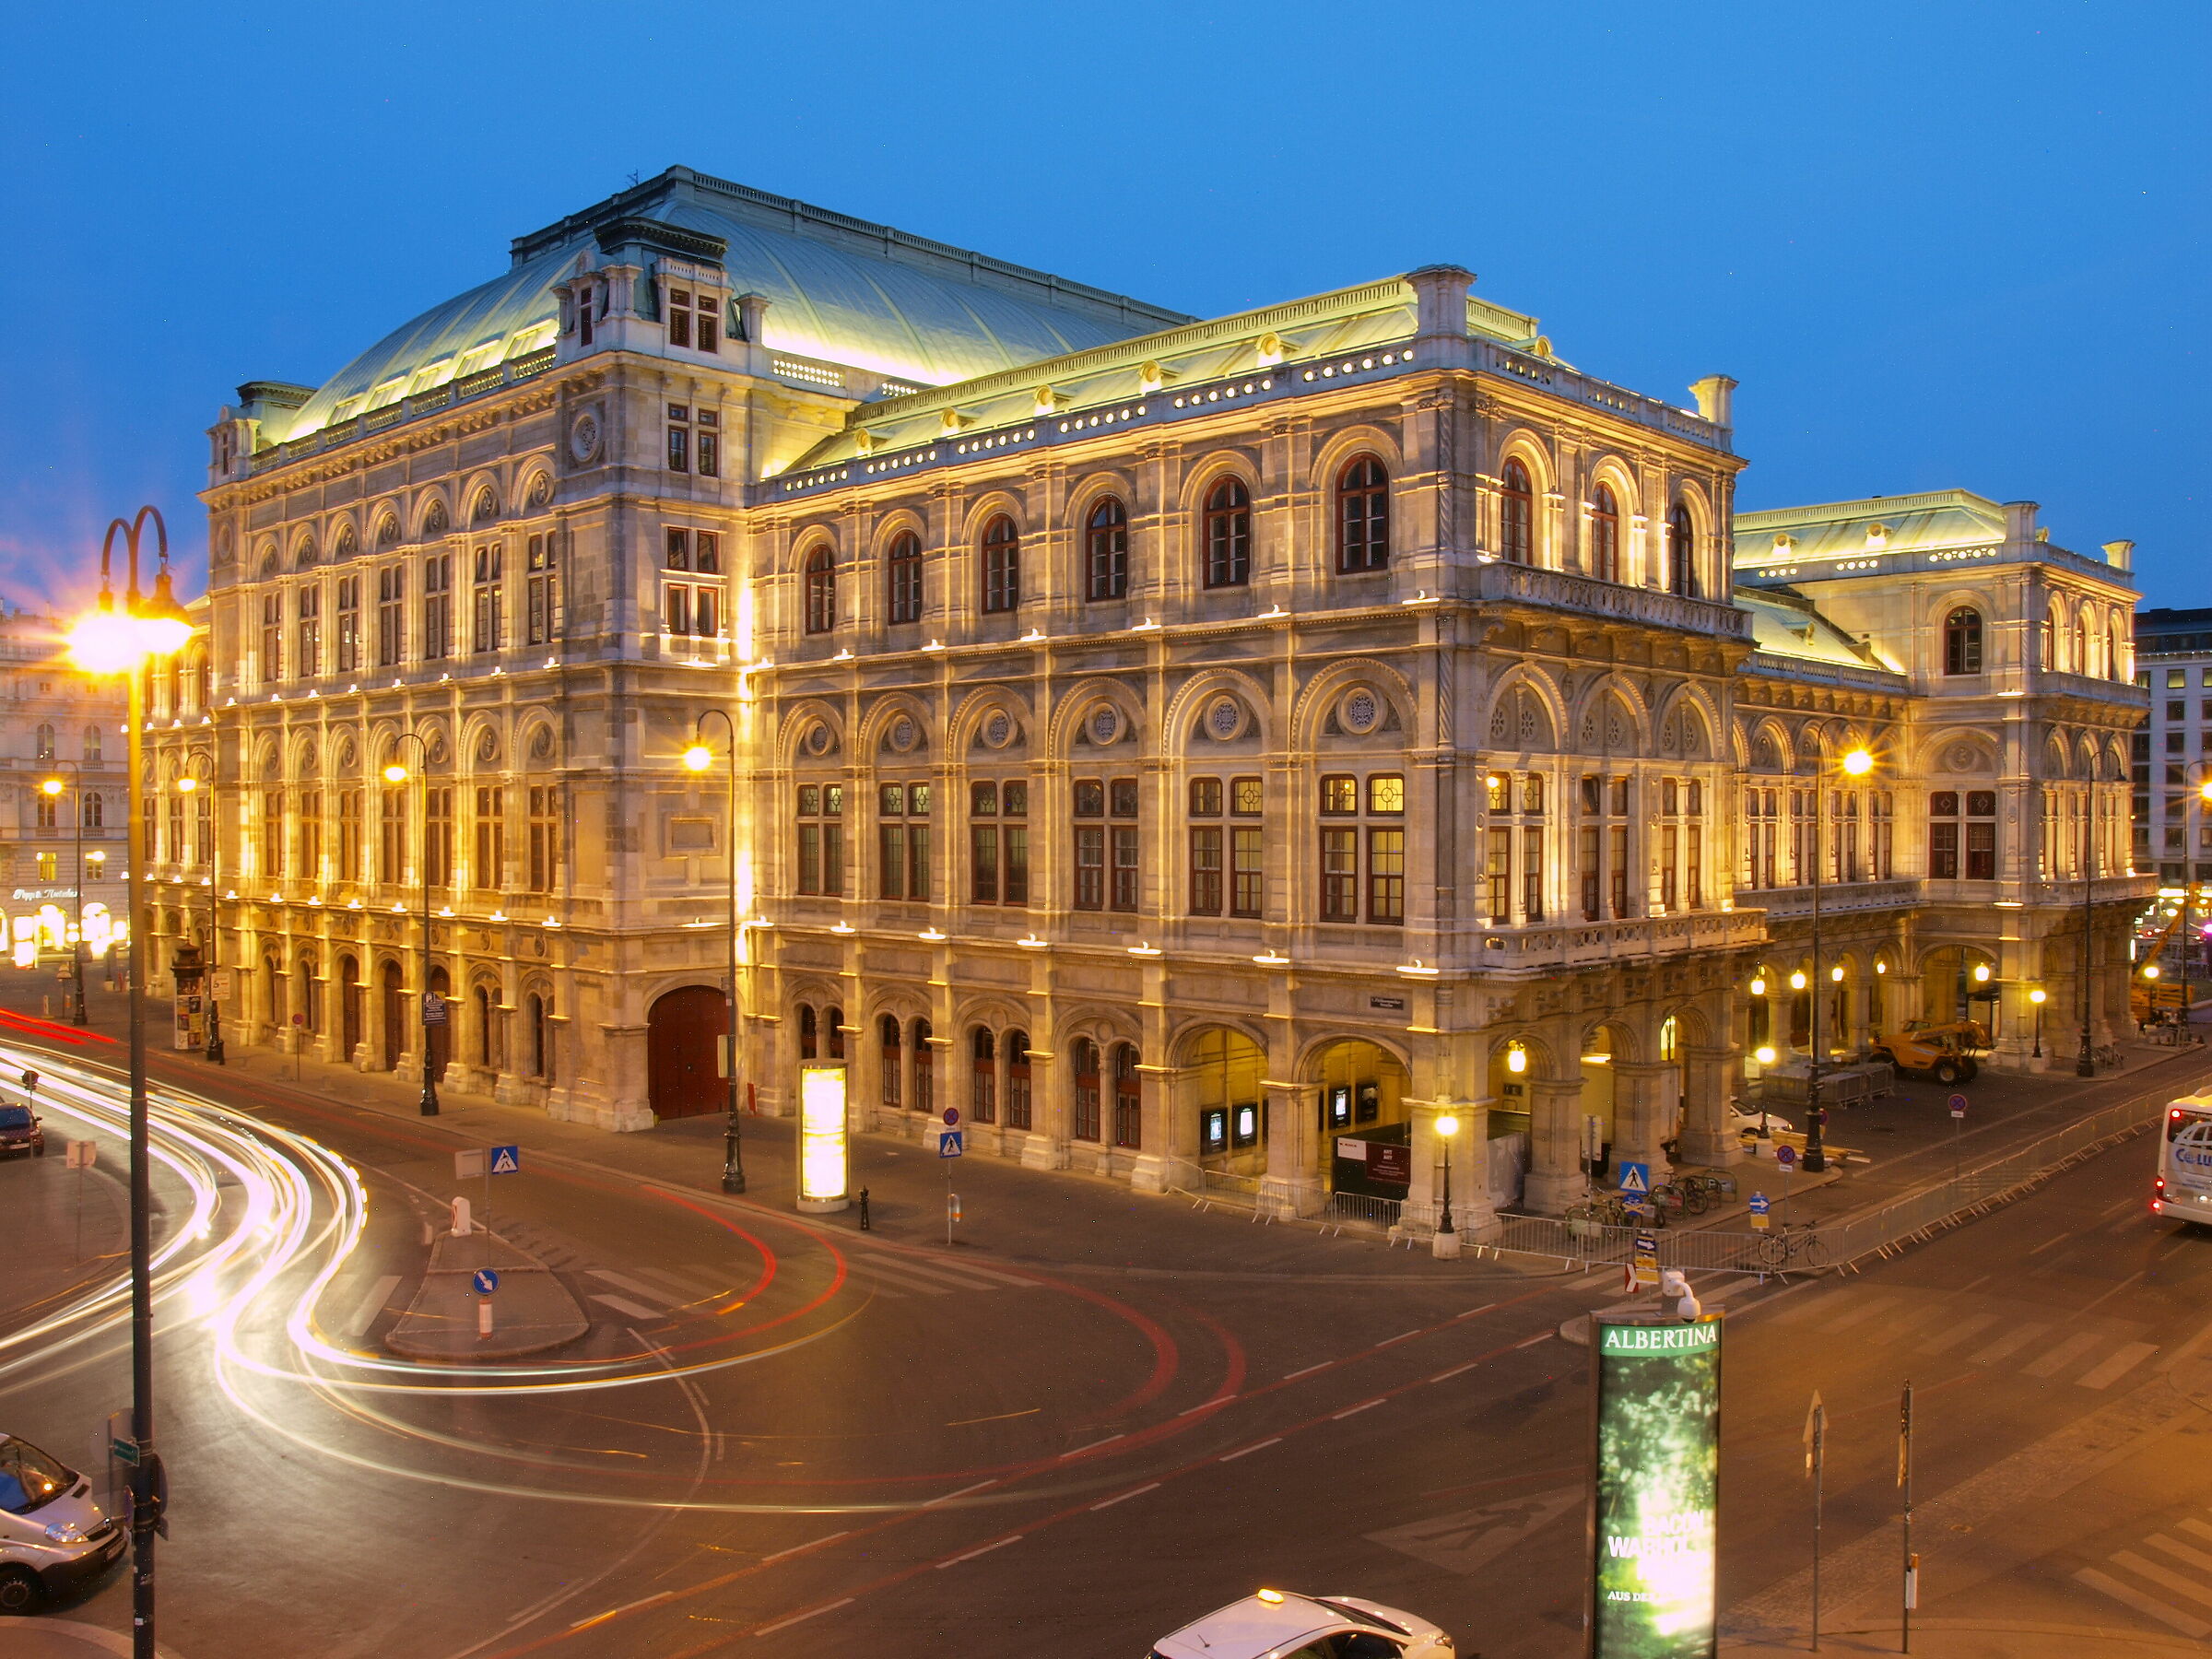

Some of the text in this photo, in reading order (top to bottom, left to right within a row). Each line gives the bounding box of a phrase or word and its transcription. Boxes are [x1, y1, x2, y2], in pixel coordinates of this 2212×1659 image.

[1605, 1324, 1717, 1349] ALBERTINA
[1643, 1509, 1704, 1535] BACON
[1607, 1535, 1694, 1558] WARHOL
[1607, 1591, 1630, 1602] AUS
